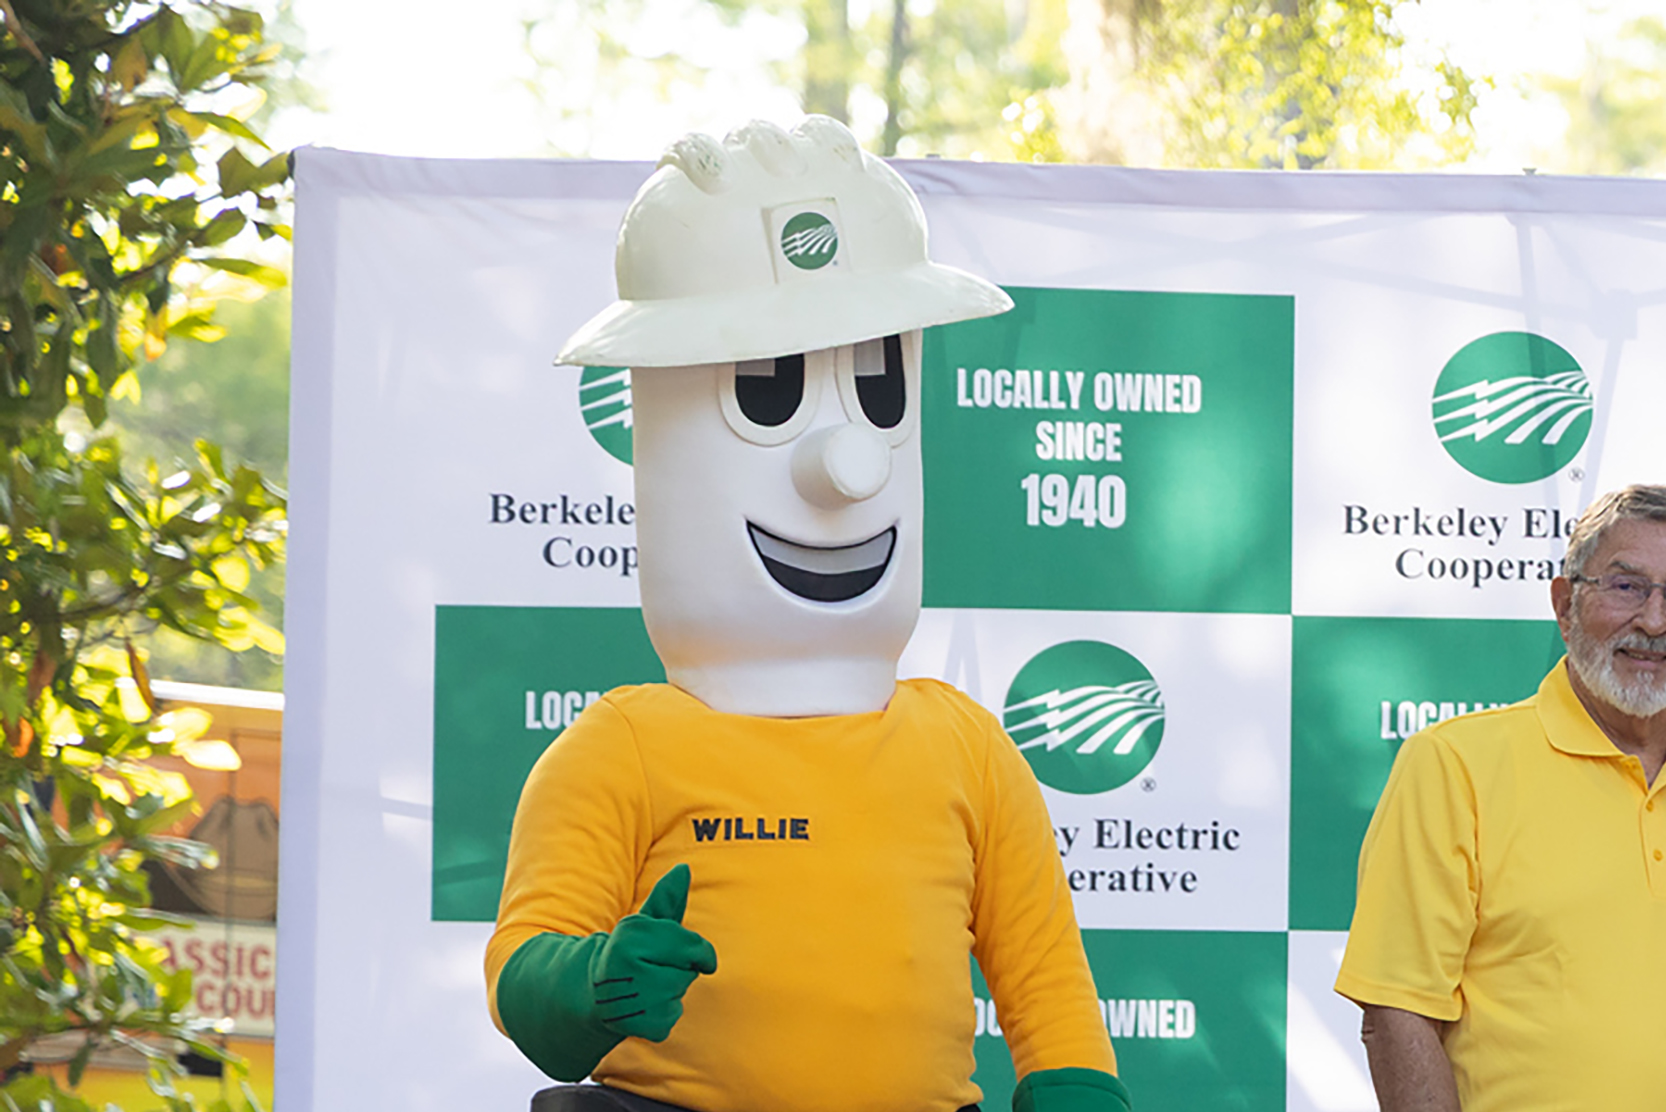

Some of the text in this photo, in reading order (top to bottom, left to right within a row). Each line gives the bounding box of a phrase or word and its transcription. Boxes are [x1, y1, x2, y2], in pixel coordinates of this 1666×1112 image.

[957, 368, 1203, 414] LOCALLY OWNED
[1035, 420, 1122, 462] SINCE
[489, 492, 636, 525] Berkele
[1020, 472, 1127, 529] 1940
[1342, 504, 1509, 546] Berkeley
[1394, 548, 1565, 588] Coopera
[691, 817, 810, 842] WILLIE
[1093, 818, 1240, 851] Electric
[1067, 863, 1198, 893] erative
